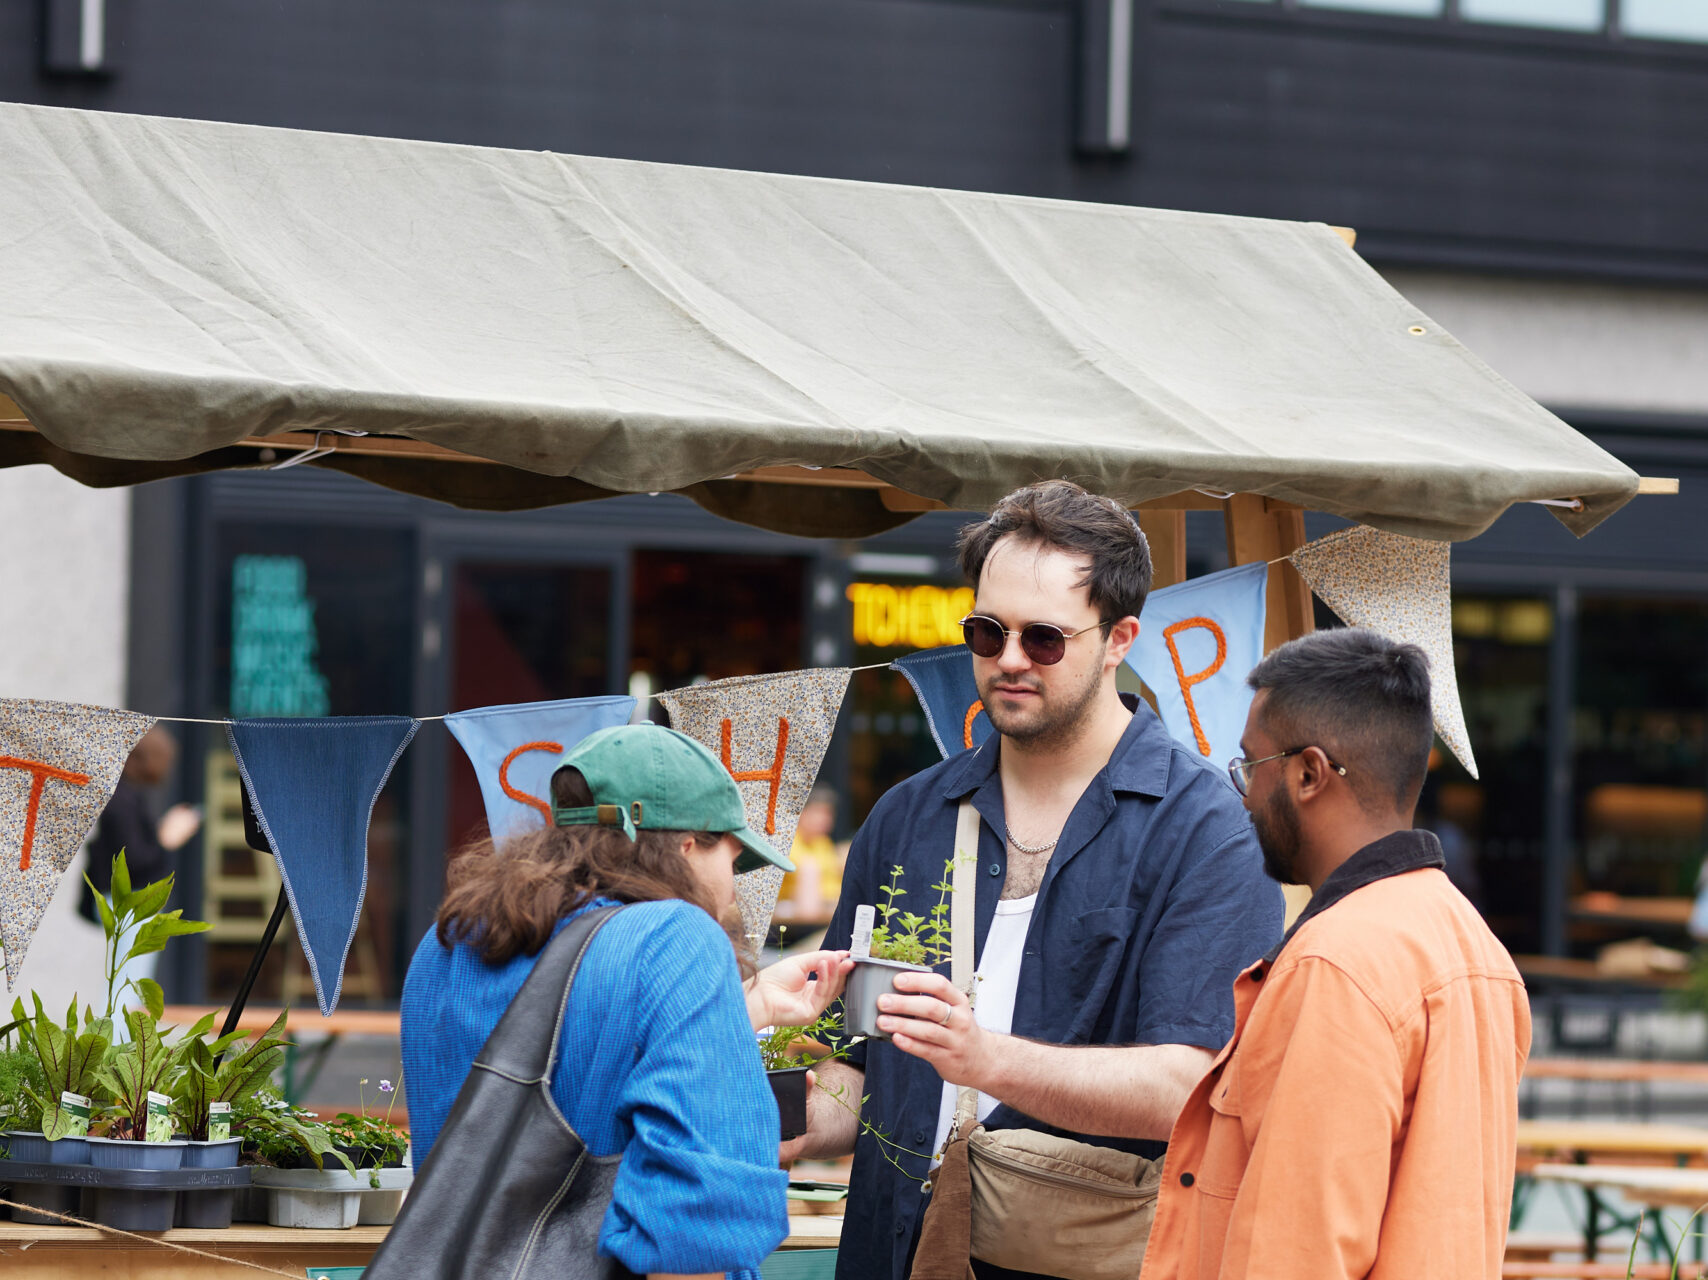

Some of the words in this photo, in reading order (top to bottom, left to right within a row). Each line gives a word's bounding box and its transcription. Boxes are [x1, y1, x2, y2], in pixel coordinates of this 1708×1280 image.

[721, 717, 789, 835] H
[1163, 616, 1227, 757] P
[0, 755, 90, 871] T
